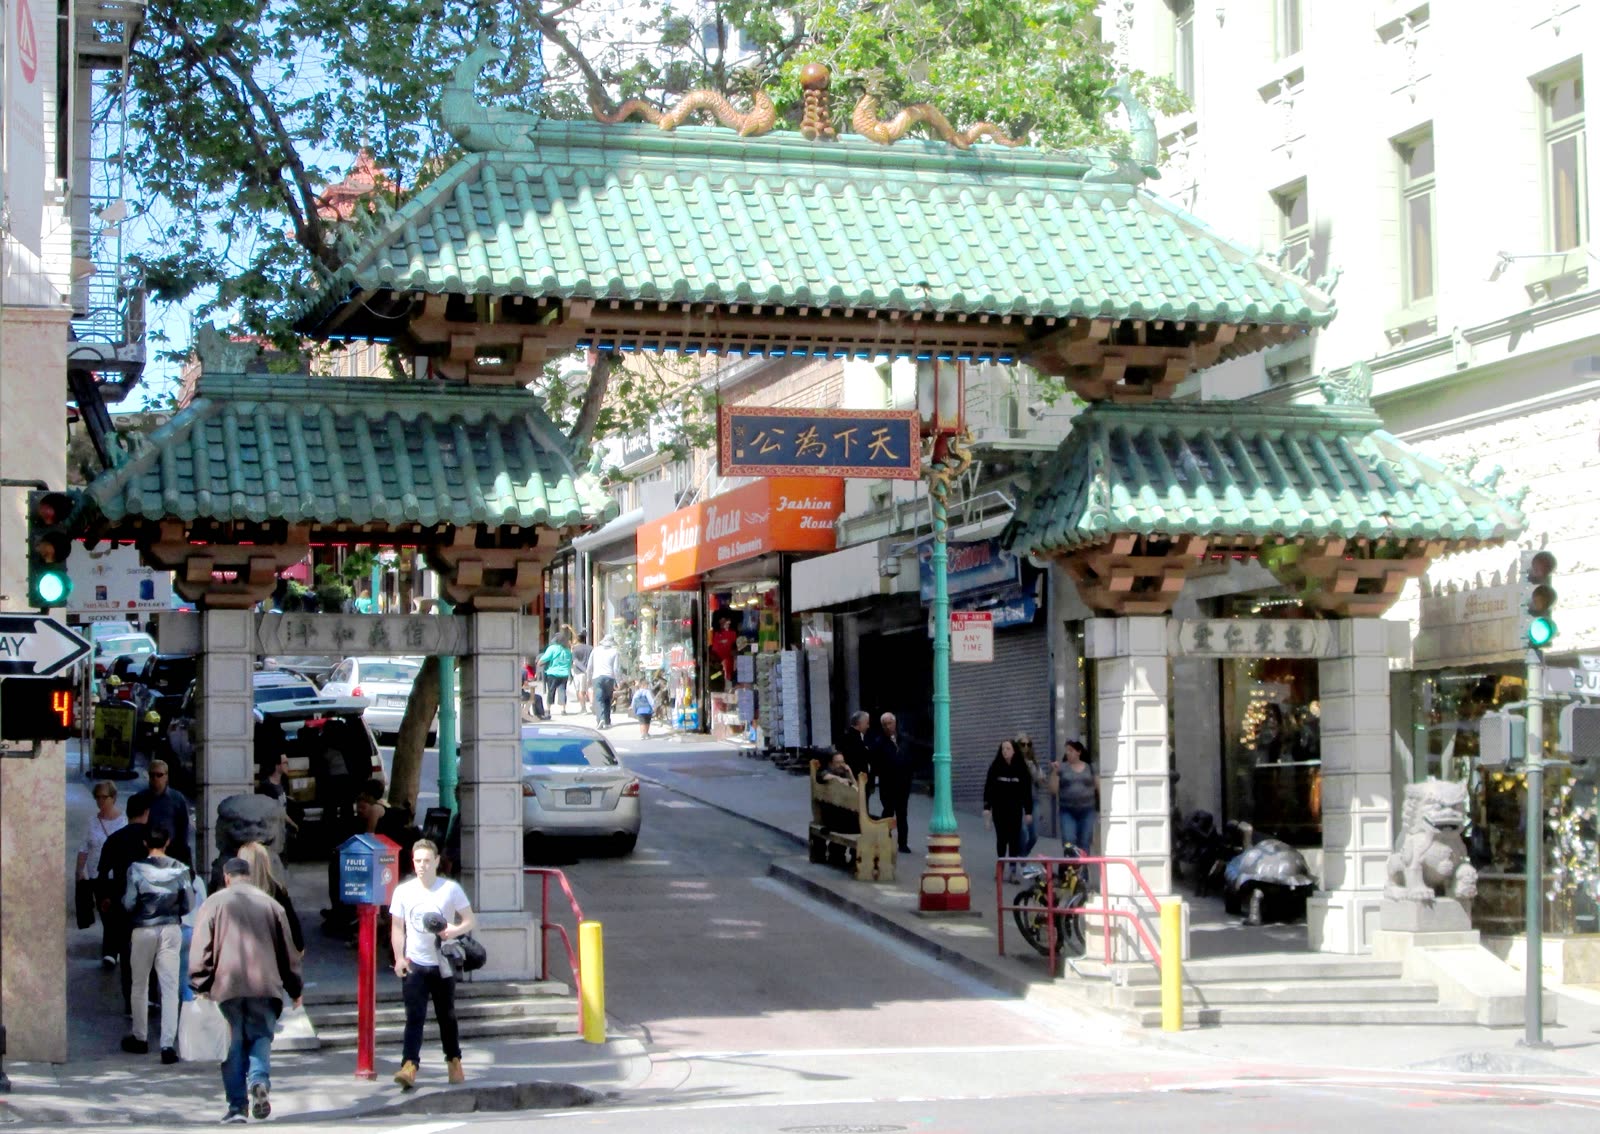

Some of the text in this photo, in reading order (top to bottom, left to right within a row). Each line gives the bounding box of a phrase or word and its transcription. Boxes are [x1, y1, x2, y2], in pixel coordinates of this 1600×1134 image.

[776, 496, 832, 512] Fashion
[799, 515, 834, 529] Hous
[658, 505, 740, 566] Fashion House
[952, 621, 964, 631] NO
[962, 643, 982, 651] TIME
[53, 690, 70, 727] 4
